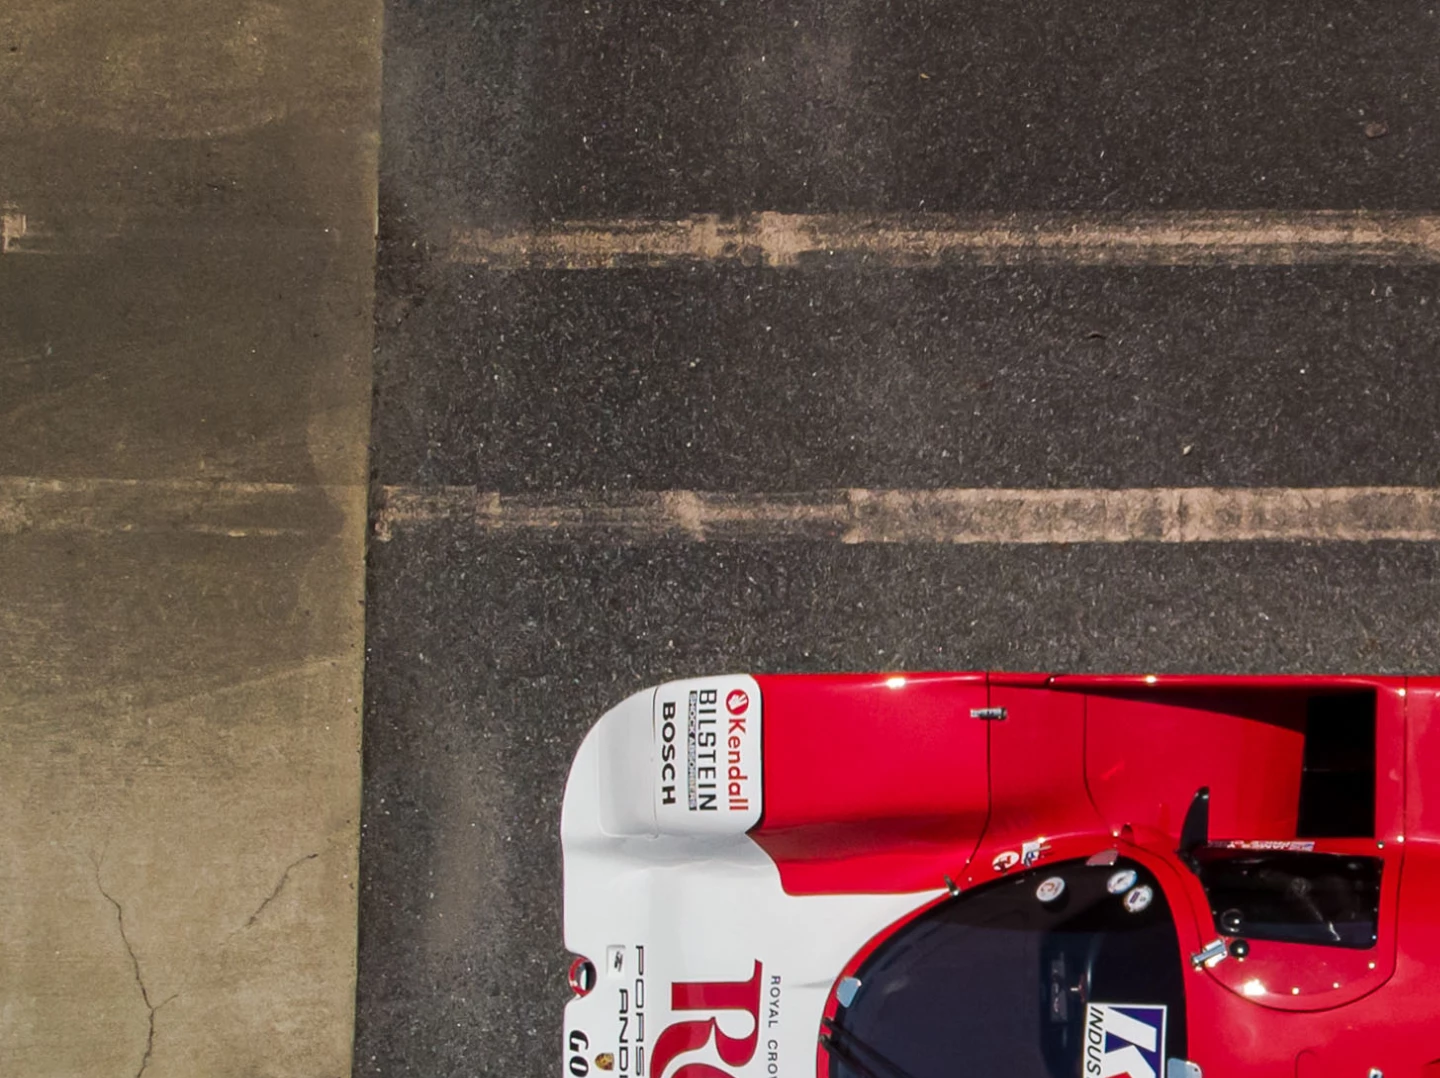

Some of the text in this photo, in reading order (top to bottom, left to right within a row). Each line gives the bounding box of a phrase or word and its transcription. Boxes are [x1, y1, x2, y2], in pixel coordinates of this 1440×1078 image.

[662, 701, 676, 805] BOSCH
[697, 689, 718, 811] BILSTEIN
[728, 718, 749, 811] Kendall
[768, 975, 782, 1028] ROYAL
